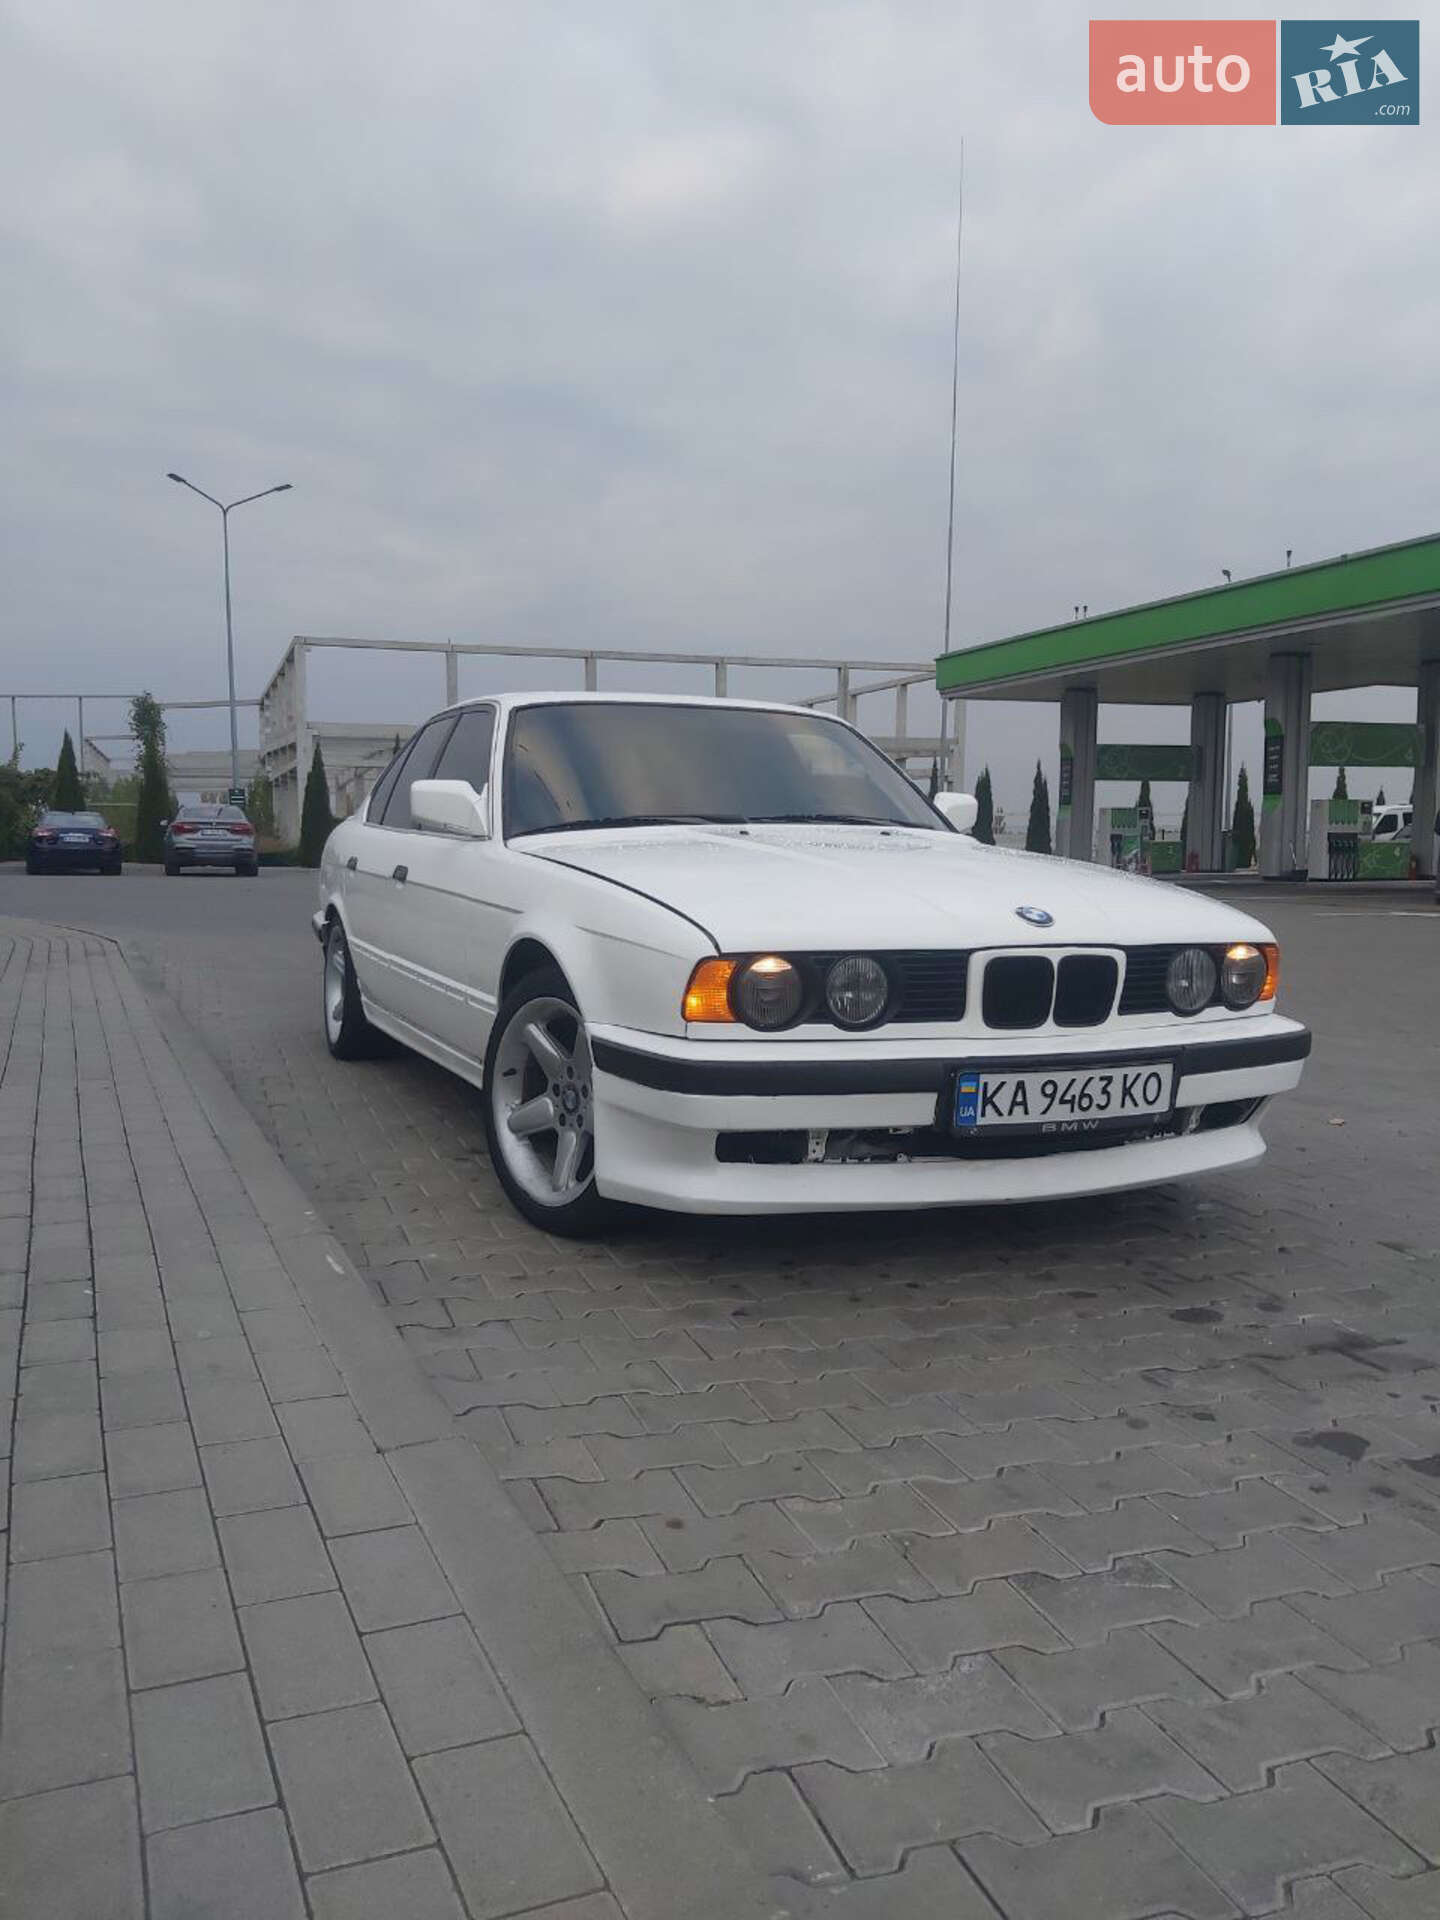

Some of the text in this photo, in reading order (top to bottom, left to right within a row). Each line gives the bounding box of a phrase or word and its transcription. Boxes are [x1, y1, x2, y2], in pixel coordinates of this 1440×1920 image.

[981, 1072, 1162, 1118] KA 9463 KO
[959, 1106, 975, 1117] UA
[1042, 1120, 1100, 1133] BMW
